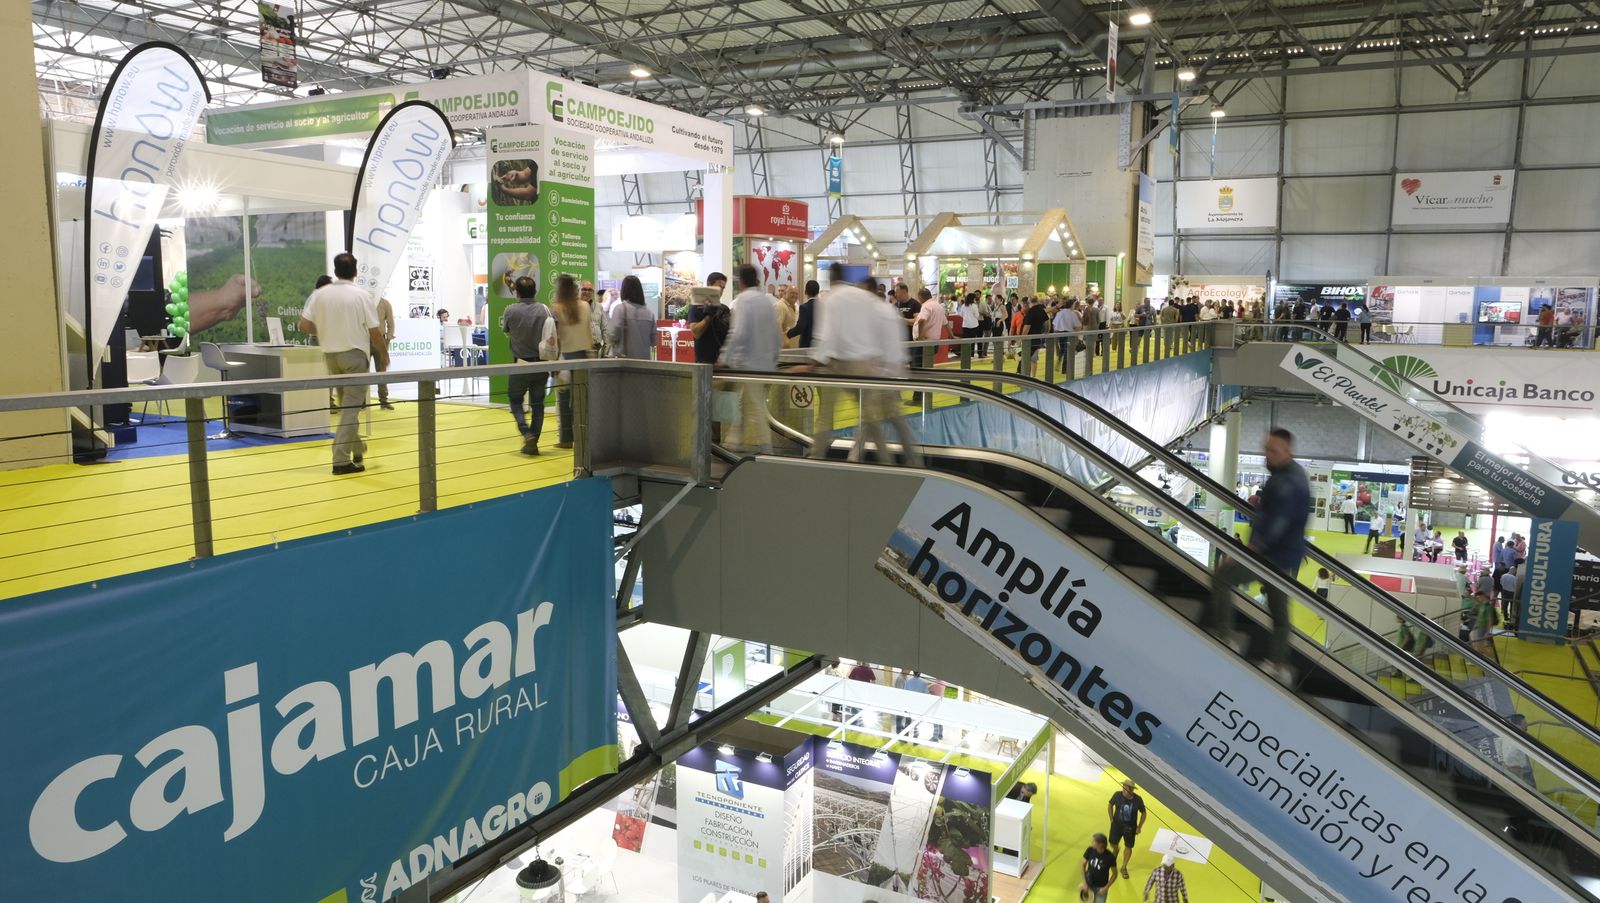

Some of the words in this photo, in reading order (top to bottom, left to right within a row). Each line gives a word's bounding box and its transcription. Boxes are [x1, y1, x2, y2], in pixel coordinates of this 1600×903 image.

[104, 66, 140, 148] www.hpnow.eu
[450, 112, 488, 122] COOPERATIVA
[489, 109, 519, 118] ANDALUZA
[567, 98, 655, 134] CAMPOEJIDO
[165, 138, 184, 177] peroxide
[185, 89, 201, 117] simple
[245, 124, 255, 134] de
[256, 120, 285, 132] servicio
[286, 119, 293, 129] al
[294, 117, 313, 127] socio
[315, 118, 321, 127] y
[322, 115, 330, 124] al
[331, 111, 370, 124] agricultor
[567, 117, 594, 131] SOCIEDAD
[595, 124, 629, 139] COOPERATIVA
[629, 132, 655, 145] ANDALUZA
[499, 140, 539, 149] CAMPOEJIDO
[671, 125, 701, 139] Cultivando
[702, 133, 707, 141] el
[707, 135, 723, 145] futuro
[366, 121, 399, 188] www.hpnow.eu
[551, 147, 560, 155] de
[561, 149, 589, 162] servicio
[694, 141, 709, 151] desde
[710, 145, 724, 154] 1979
[412, 181, 430, 211] peroxide
[425, 160, 438, 181] made
[433, 137, 449, 161] simple
[553, 159, 560, 167] al
[562, 160, 580, 170] socio
[582, 165, 586, 173] y
[558, 171, 590, 183] agricultor
[356, 119, 440, 253] hpnow
[561, 196, 590, 206] Suministros
[1415, 194, 1448, 205] Vícar
[1454, 193, 1494, 204] mucho
[496, 213, 503, 221] Tu
[504, 212, 535, 221] confianza
[770, 216, 786, 227] royal
[490, 236, 541, 246] responsabilidad
[561, 252, 588, 260] Estaciones
[1188, 288, 1248, 299] AgroEcology
[1320, 286, 1365, 295] BIHOX
[278, 306, 304, 316] Cultiv
[287, 322, 296, 332] el
[1312, 366, 1334, 383] El
[1331, 376, 1388, 413] Plantel
[1433, 378, 1518, 402] Unicaja
[1523, 383, 1595, 402] Banco
[1467, 460, 1489, 476] para
[1490, 471, 1500, 482] tu
[1501, 478, 1541, 507] cosecha
[1474, 450, 1485, 461] El
[1484, 454, 1514, 479] mejor
[1513, 473, 1546, 497] injerto
[931, 501, 1103, 639] Amplía
[1527, 521, 1553, 629] AGRICULTURA
[1543, 592, 1561, 631] 2000
[907, 537, 1162, 746] horizontes
[28, 601, 554, 863] cajamar
[353, 726, 443, 789] CAJA
[455, 682, 548, 745] RURAL
[697, 791, 763, 812] TECNOPONIENTE
[1204, 690, 1403, 844] Especialistas
[1405, 841, 1450, 881] en
[1453, 868, 1488, 903] la
[715, 810, 742, 824] DISEÑO
[1185, 717, 1365, 862] transmisión
[1359, 853, 1394, 879] y
[1391, 874, 1446, 903] re
[701, 826, 759, 849] CONSTRUCCIÓN
[705, 817, 753, 837] FABRICACIÓN
[382, 781, 551, 903] ADNAGRO
[692, 875, 702, 883] LOS
[703, 878, 722, 889] PILARES
[723, 884, 730, 892] DE
